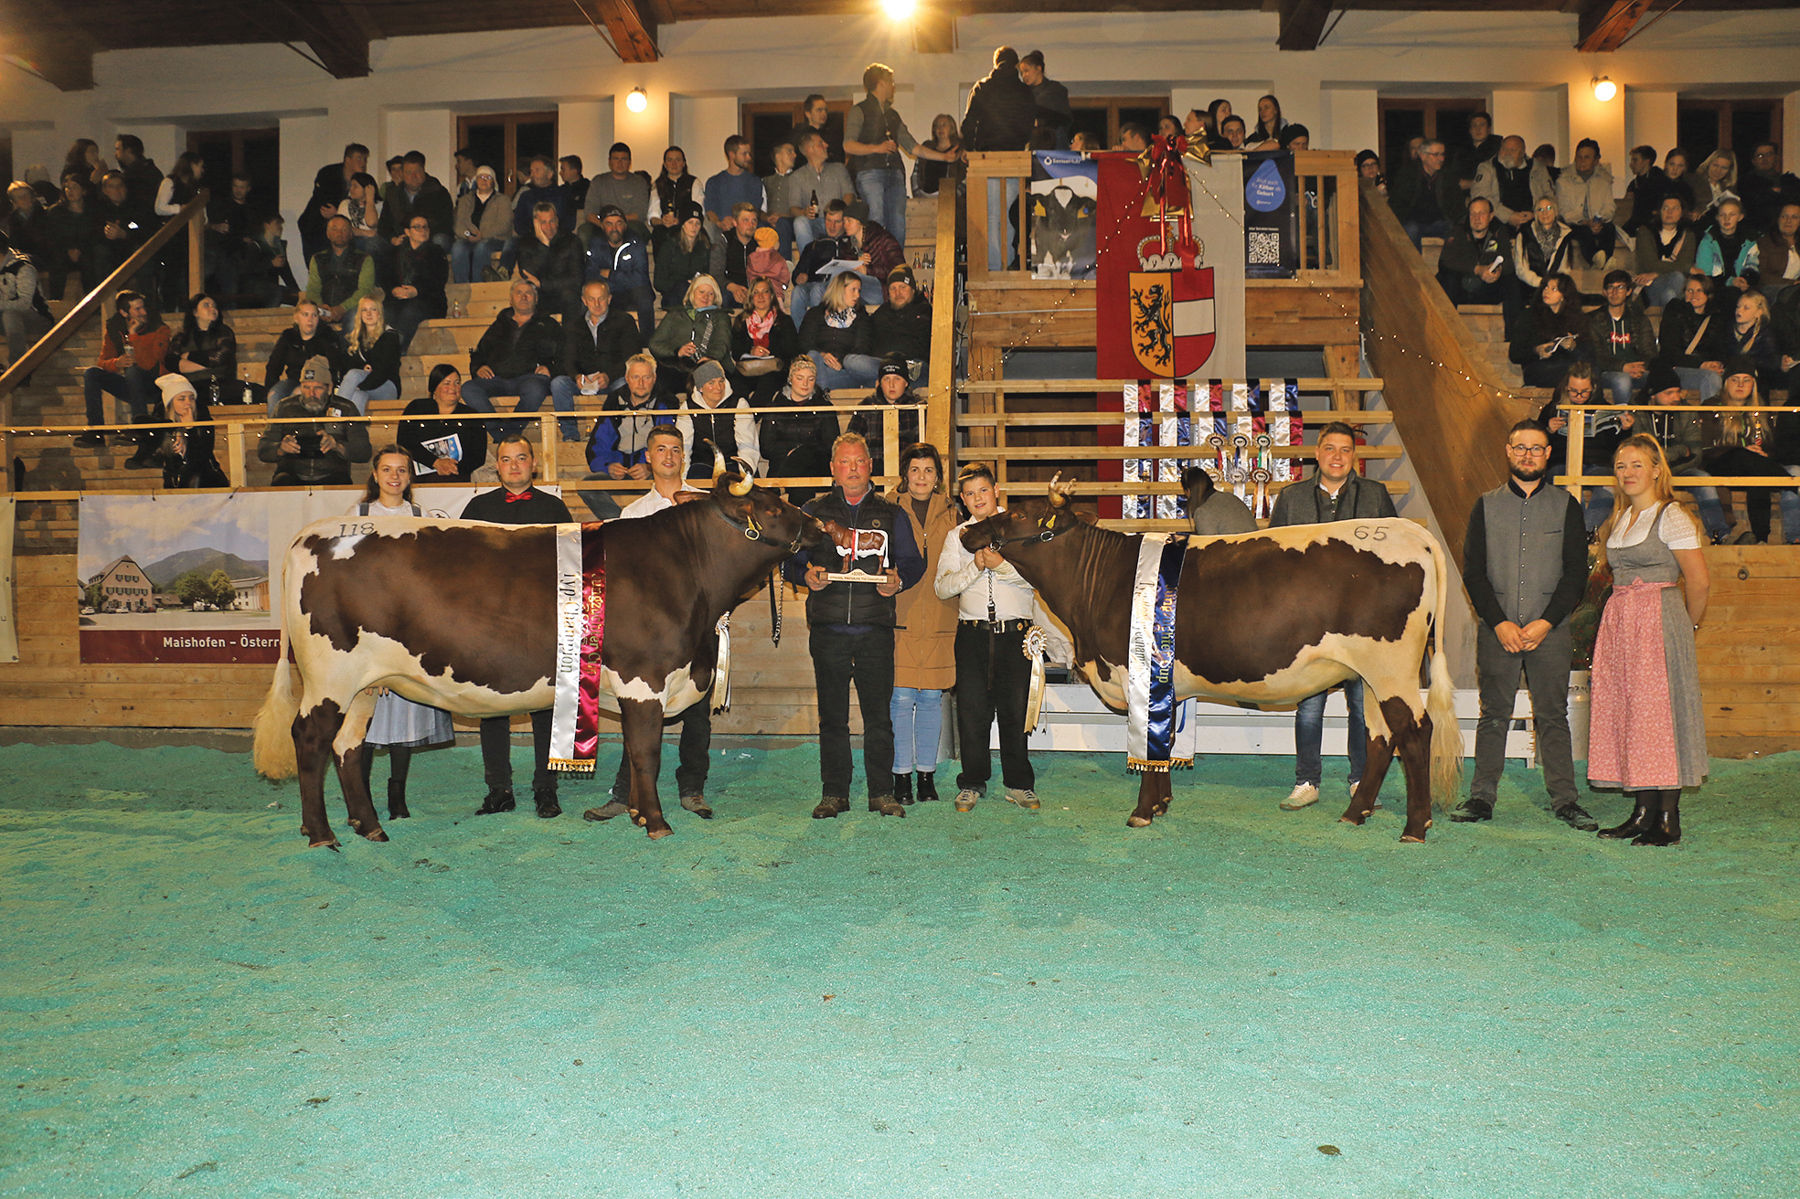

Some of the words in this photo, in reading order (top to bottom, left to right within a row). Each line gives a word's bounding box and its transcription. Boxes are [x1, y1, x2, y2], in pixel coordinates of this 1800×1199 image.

[340, 522, 374, 538] 118
[1354, 525, 1389, 541] 65
[163, 637, 226, 648] Maishofen
[240, 634, 281, 648] Österr
